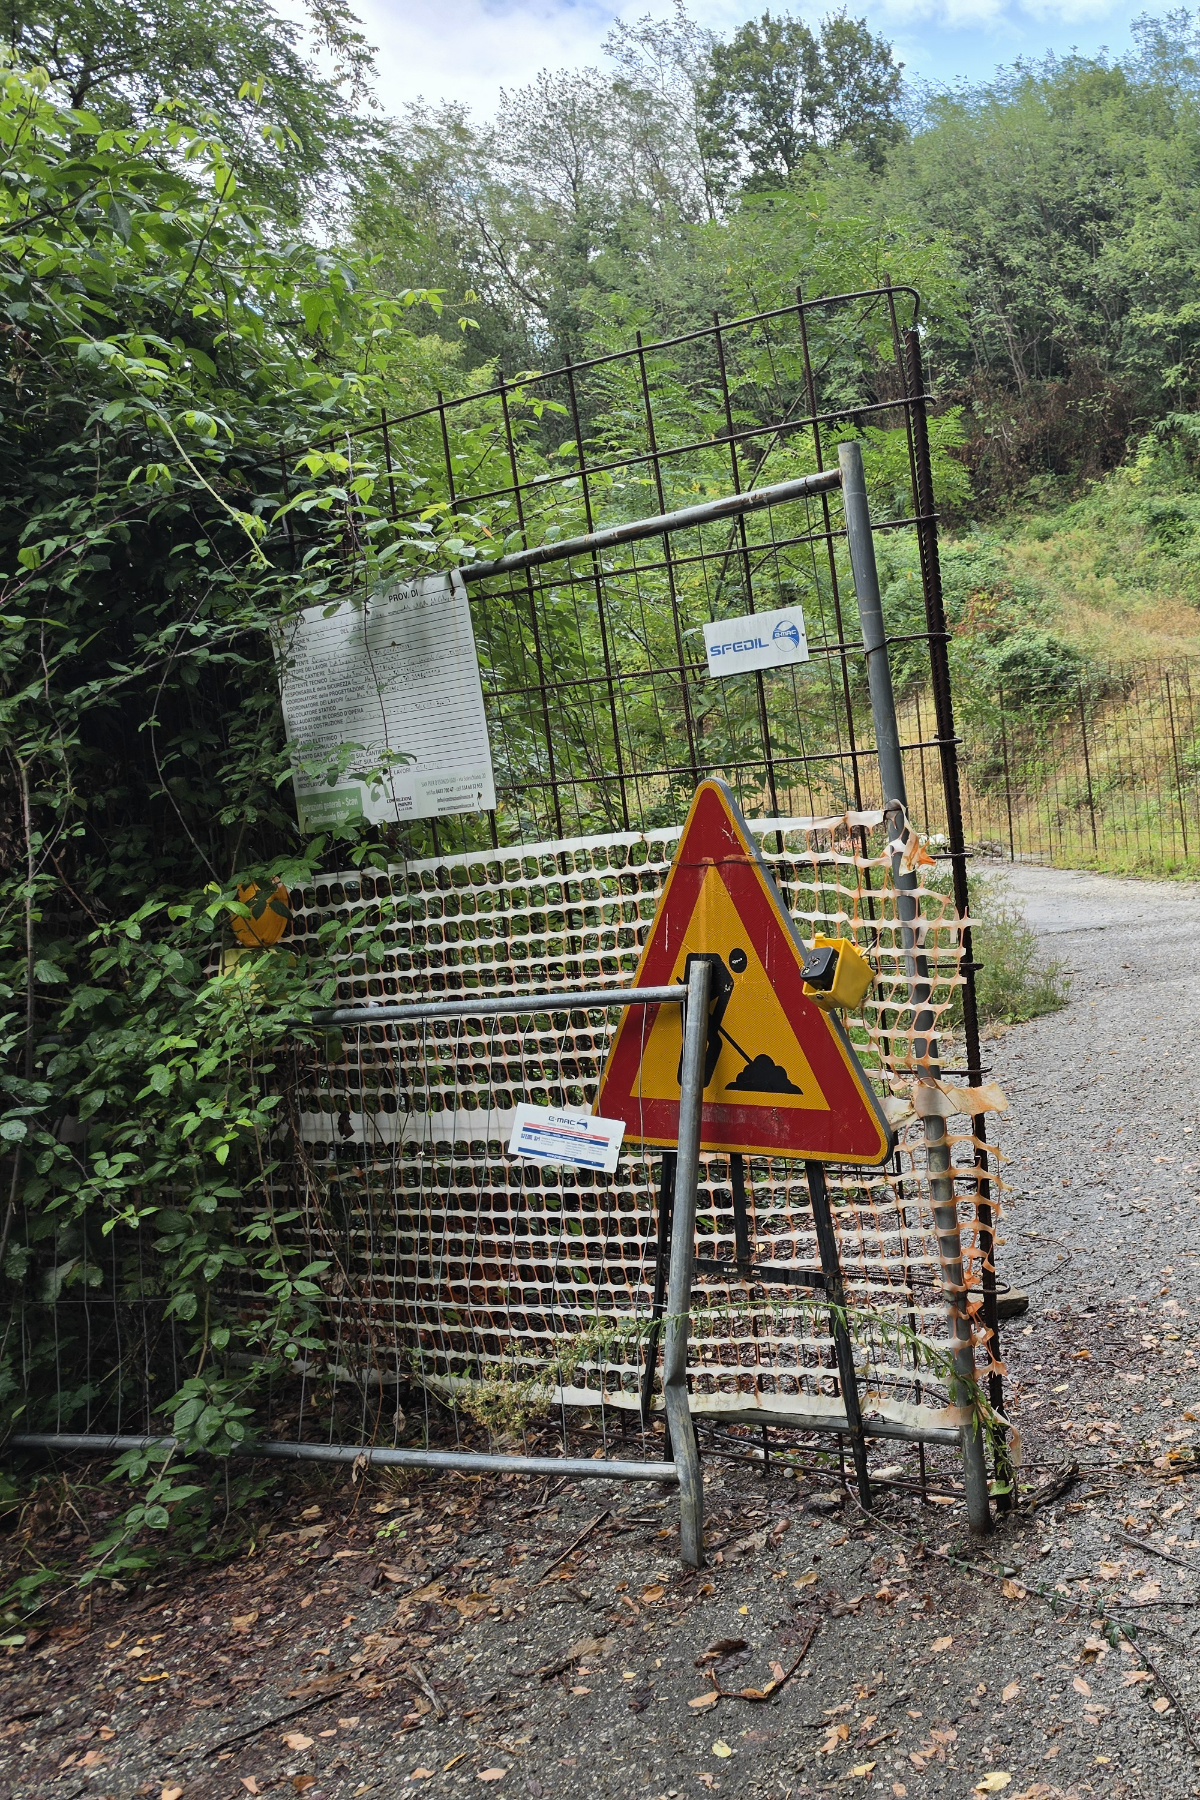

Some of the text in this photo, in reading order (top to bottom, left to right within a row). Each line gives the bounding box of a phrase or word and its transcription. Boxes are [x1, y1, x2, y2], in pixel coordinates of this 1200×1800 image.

[388, 589, 419, 603] PROV. DI
[710, 638, 770, 657] SFEDIL
[309, 678, 328, 687] TECNICO
[326, 680, 351, 690] SICUREZZA
[285, 694, 318, 706] COORDINATORE
[329, 686, 365, 697] PROGETTAZIONE
[286, 701, 319, 713] COORDINATORE
[328, 696, 344, 705] LAVORI
[287, 705, 337, 720] CALCOLATORE STATICO
[288, 715, 322, 727] COLLAUDATORE
[328, 710, 344, 720] CORSO
[314, 718, 344, 730] COSTRUZIONE
[312, 734, 338, 744] ELETTRICO
[366, 748, 387, 757] CANTIER
[345, 795, 358, 806] Scavi
